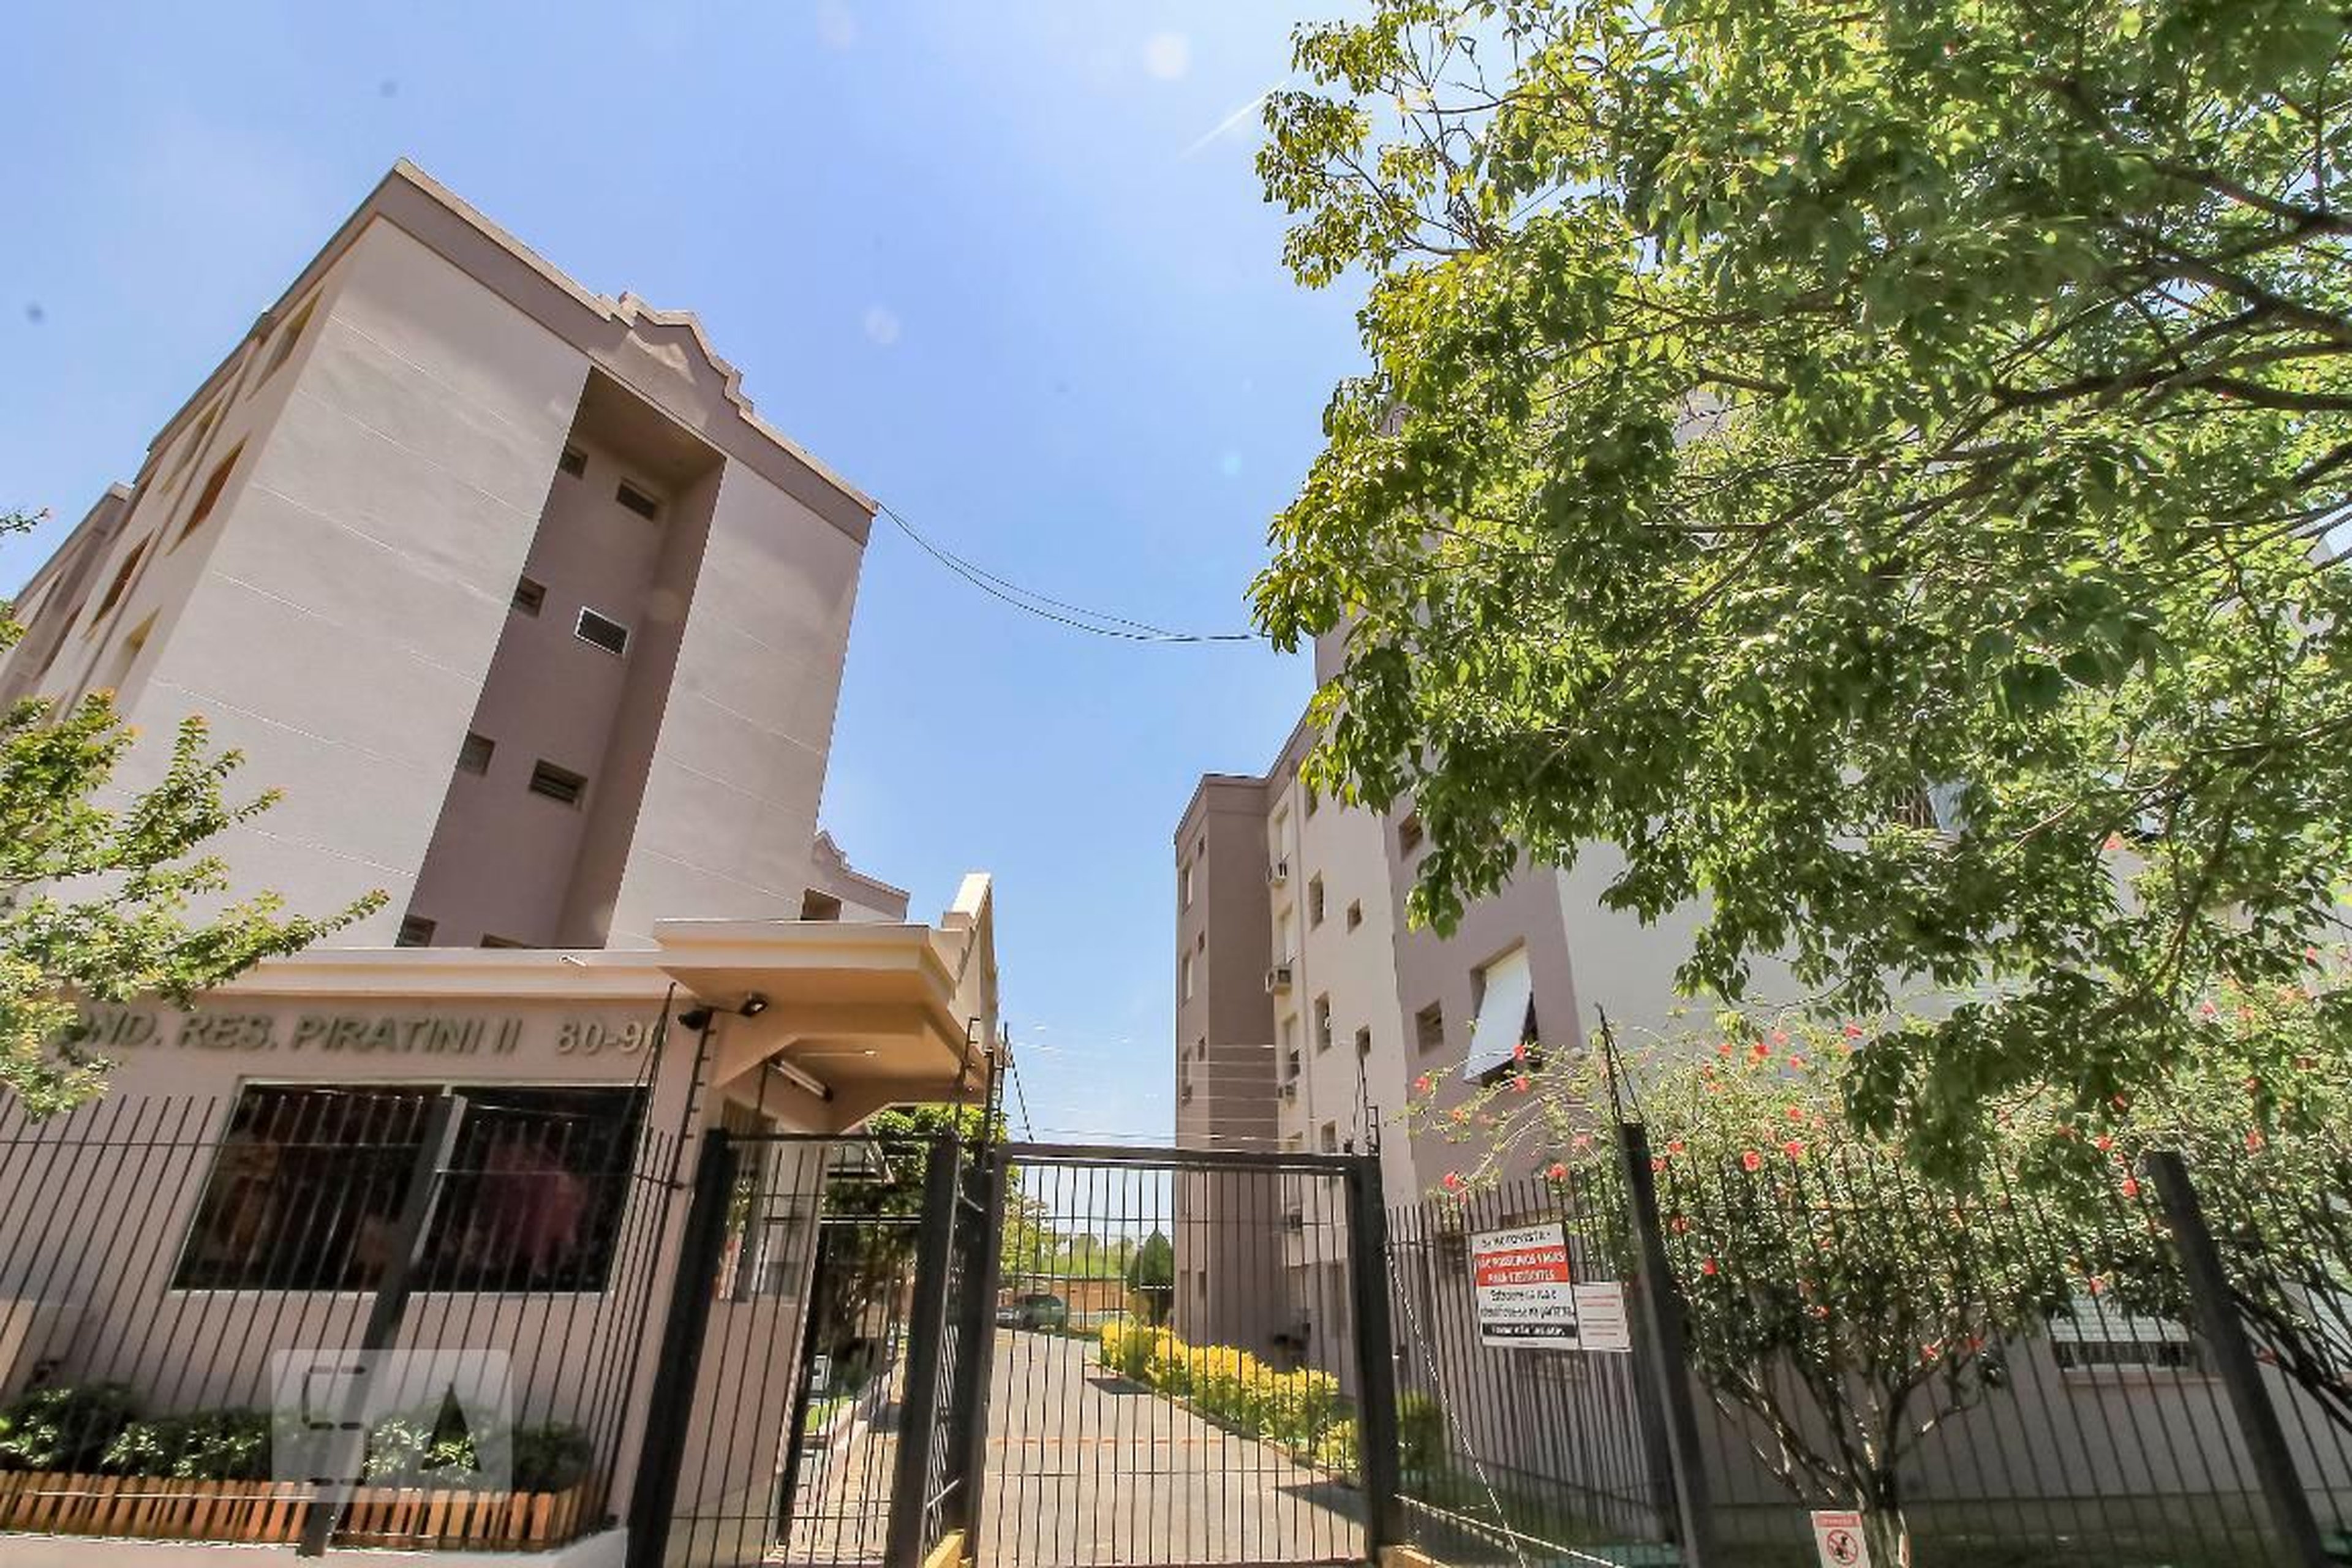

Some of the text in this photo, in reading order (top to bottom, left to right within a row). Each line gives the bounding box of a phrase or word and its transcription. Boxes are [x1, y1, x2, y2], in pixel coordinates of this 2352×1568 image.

[179, 1014, 277, 1050] RES.
[291, 1015, 485, 1054] PIRATINI
[492, 1017, 523, 1055] II
